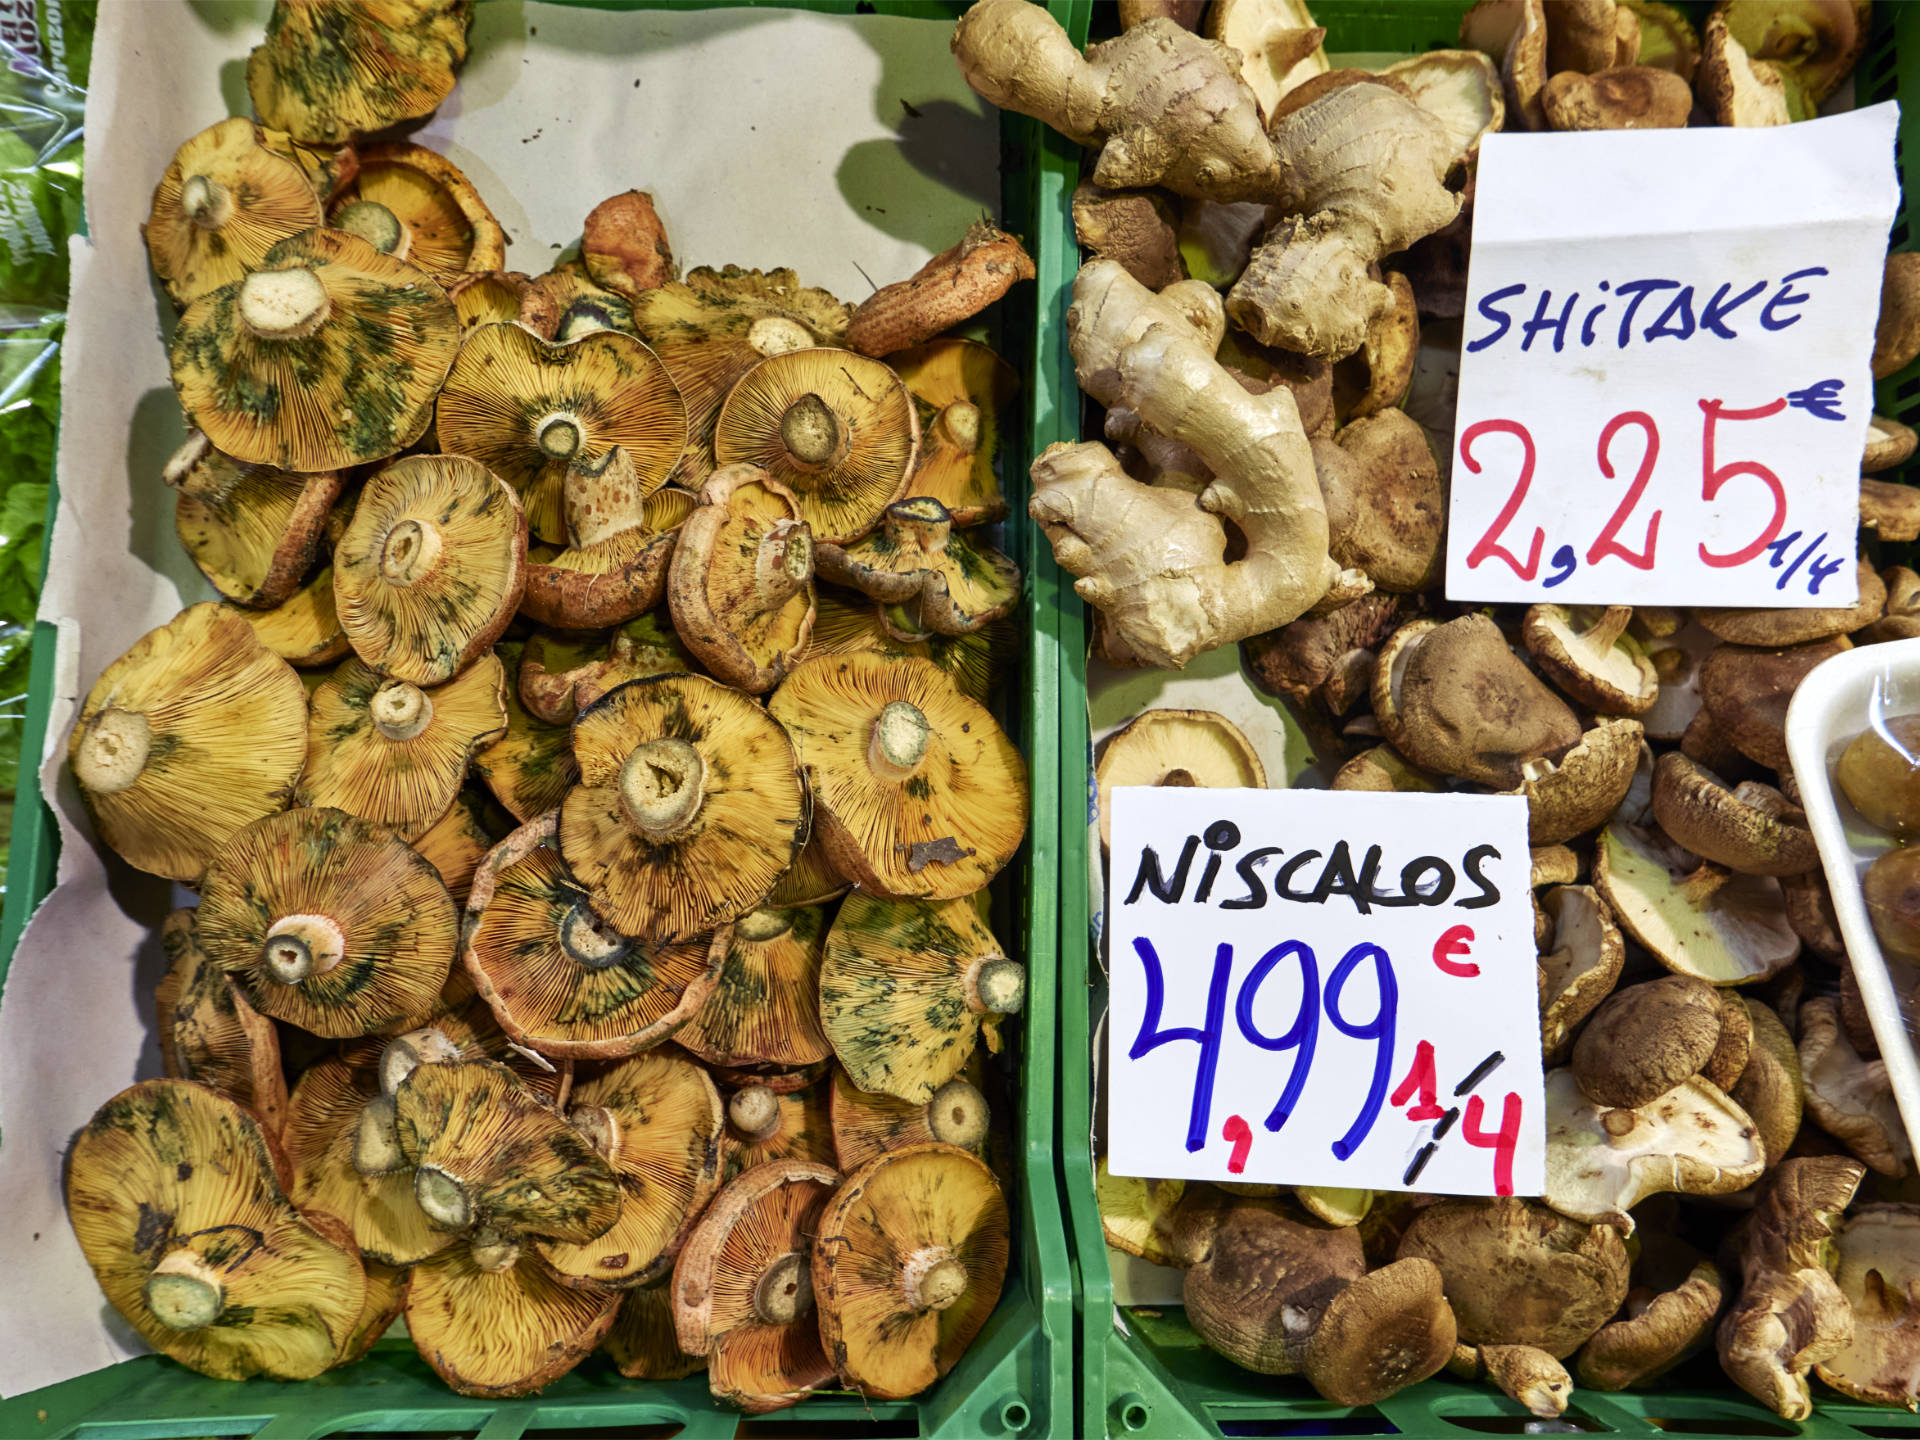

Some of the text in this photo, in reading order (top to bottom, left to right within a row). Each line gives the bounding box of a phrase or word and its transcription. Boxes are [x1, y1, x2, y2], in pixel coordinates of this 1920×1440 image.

[1766, 530, 1846, 596] 1/4
[1127, 935, 1399, 1175] 4,99
[1390, 1039, 1523, 1198] 1/4
